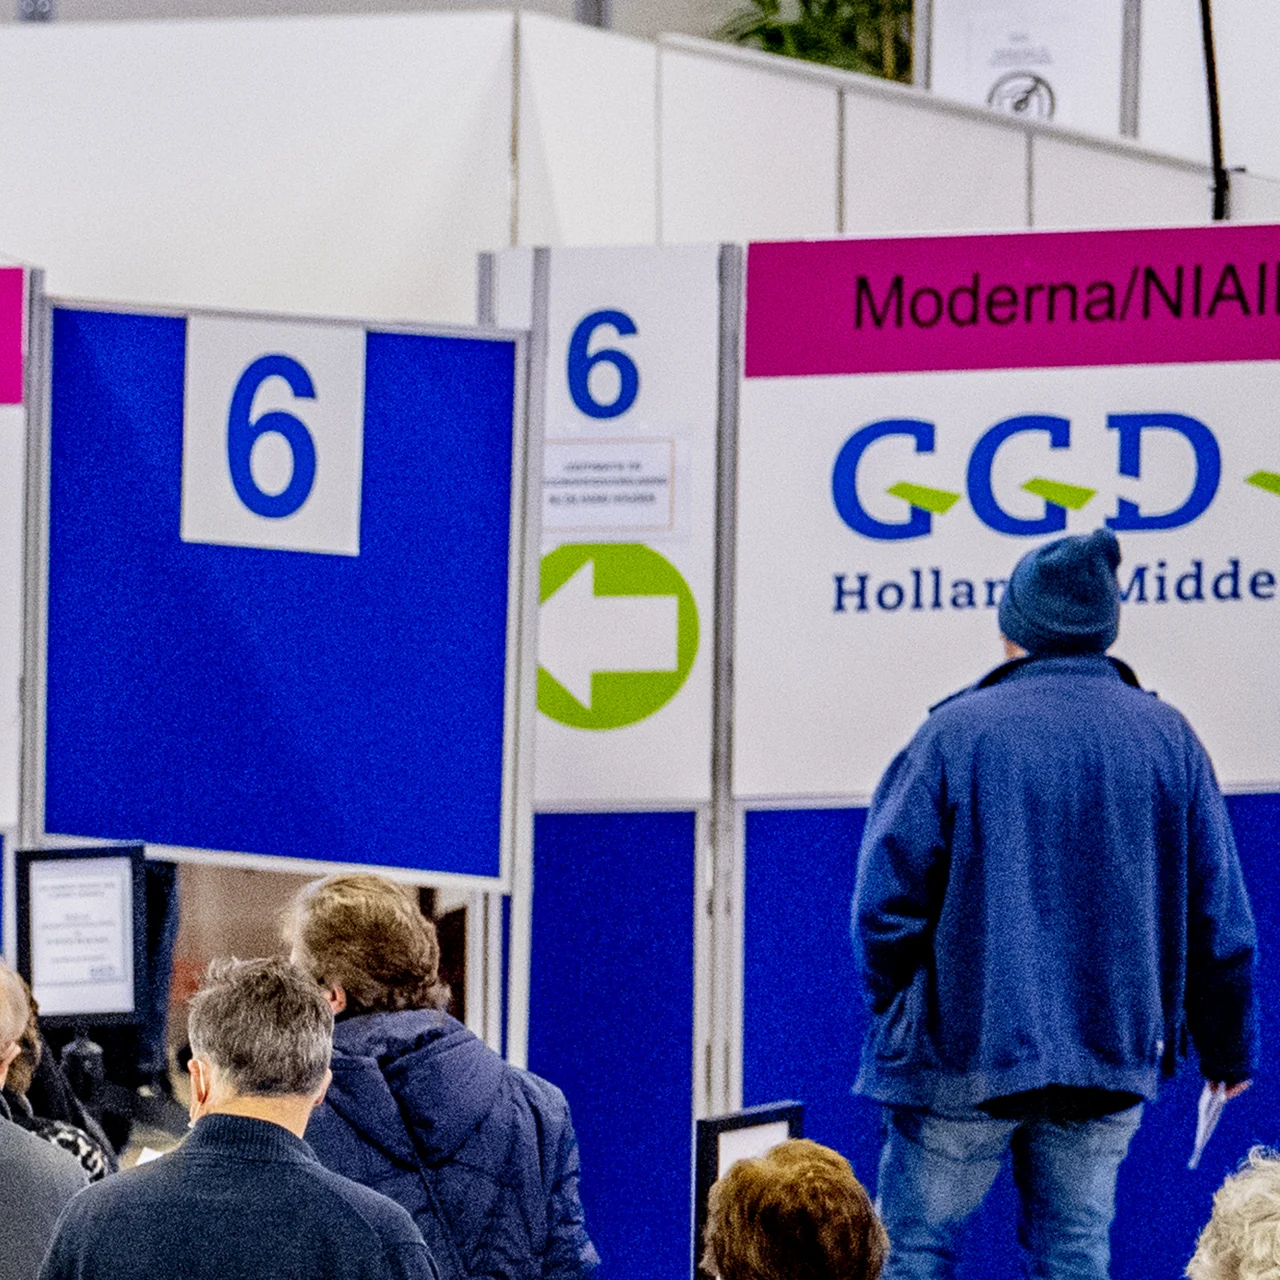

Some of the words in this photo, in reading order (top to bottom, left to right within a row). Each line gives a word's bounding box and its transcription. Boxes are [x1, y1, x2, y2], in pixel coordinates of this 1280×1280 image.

[854, 261, 1280, 330] Moderna/NIAI
[566, 309, 640, 420] 6
[226, 353, 317, 520] 6
[831, 412, 1223, 542] GGD
[833, 567, 1008, 613] Hollan
[1118, 556, 1277, 603] Midde
